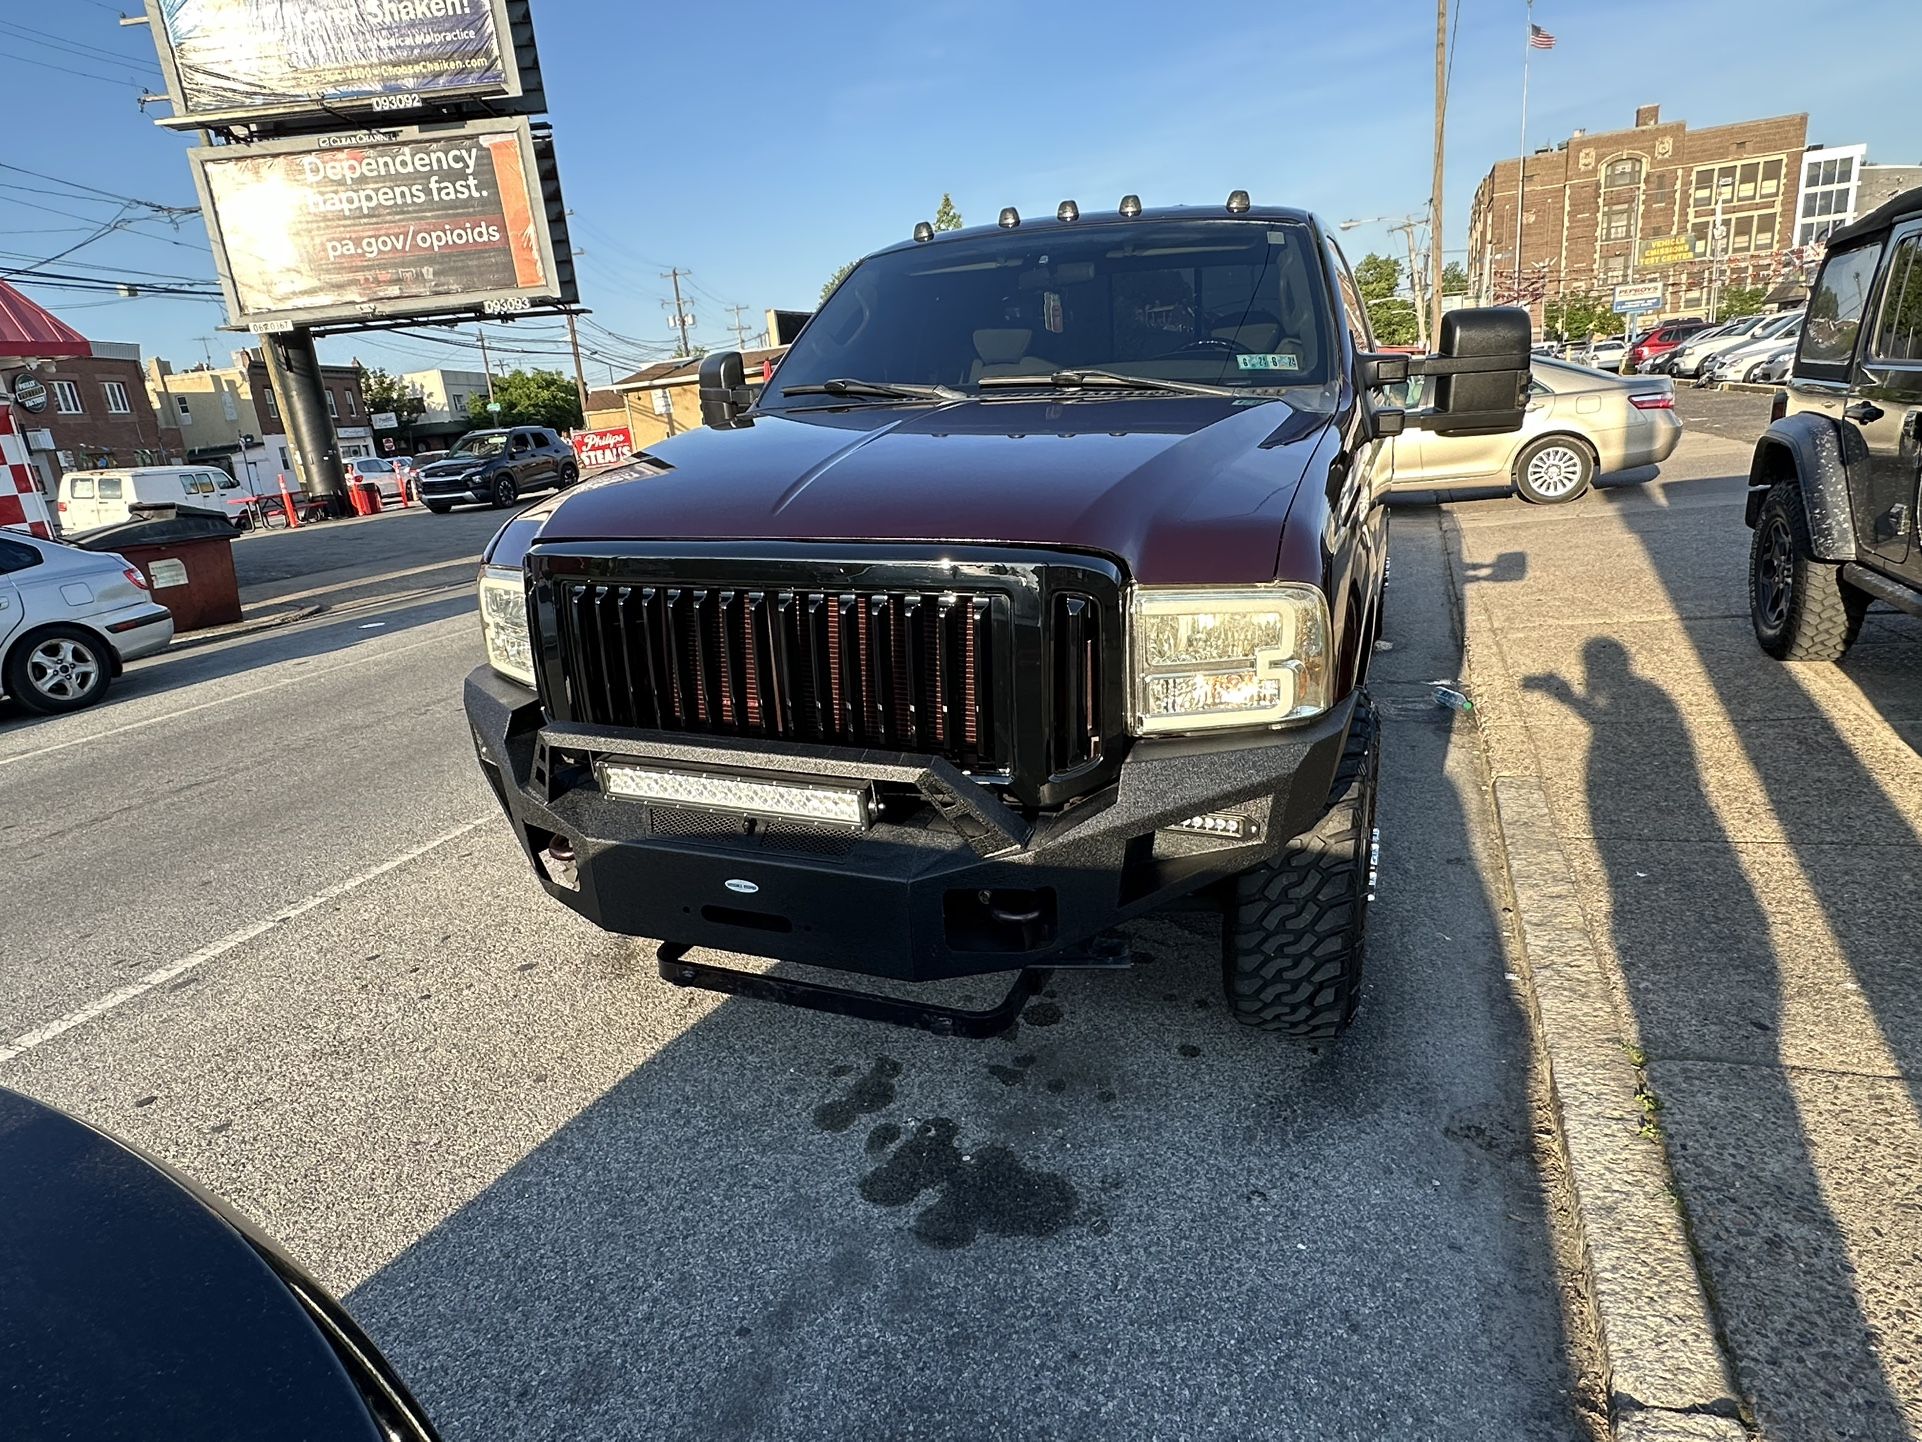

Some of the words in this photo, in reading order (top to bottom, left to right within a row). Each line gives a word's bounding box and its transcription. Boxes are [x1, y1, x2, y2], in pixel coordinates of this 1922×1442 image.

[365, 0, 471, 23] Shaken!
[415, 28, 476, 45] Malpractice
[381, 56, 488, 78] ChooseChaiken.com
[374, 94, 421, 110] 093092
[303, 147, 478, 184] Dependency
[305, 182, 425, 215] happens
[429, 175, 489, 202] fast.
[326, 221, 500, 260] pa.gov/opioids
[1651, 236, 1686, 248] VEHICLE
[1644, 244, 1689, 257] EMISSIONS
[1661, 252, 1694, 262] CENTER
